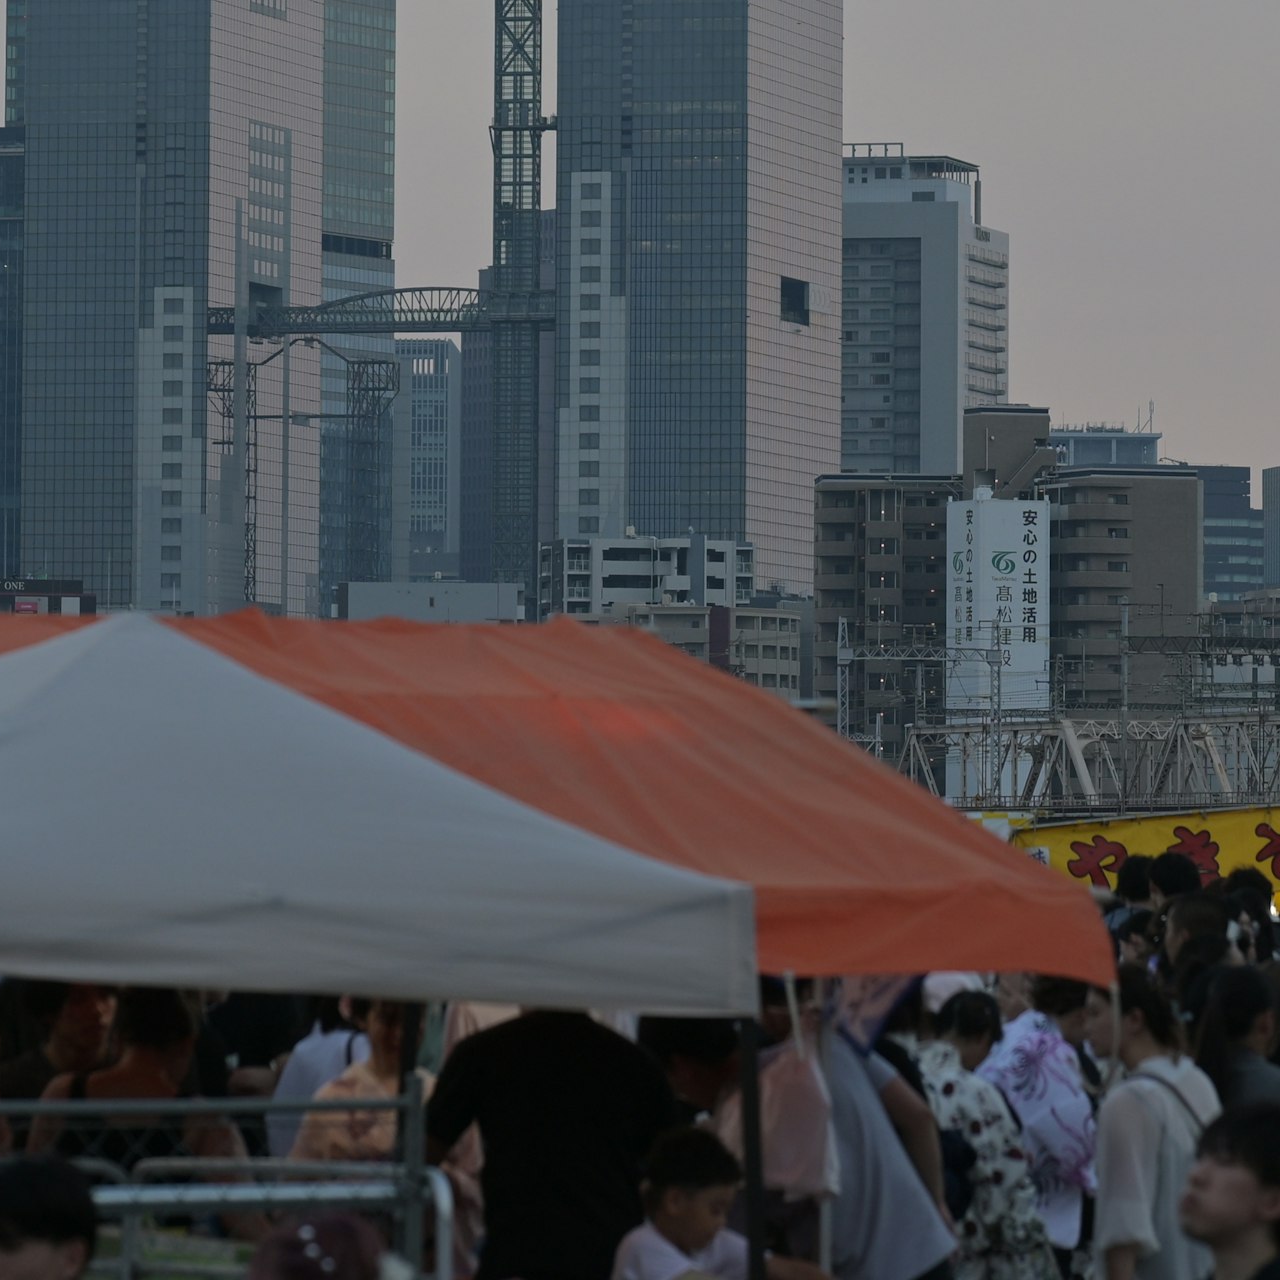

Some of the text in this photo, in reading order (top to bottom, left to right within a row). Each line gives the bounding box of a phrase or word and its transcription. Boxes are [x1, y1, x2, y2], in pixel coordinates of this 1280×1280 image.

[4, 581, 25, 591] ONE
[965, 509, 974, 642] 安心の土地活用
[1022, 509, 1038, 643] 安心の土地活用
